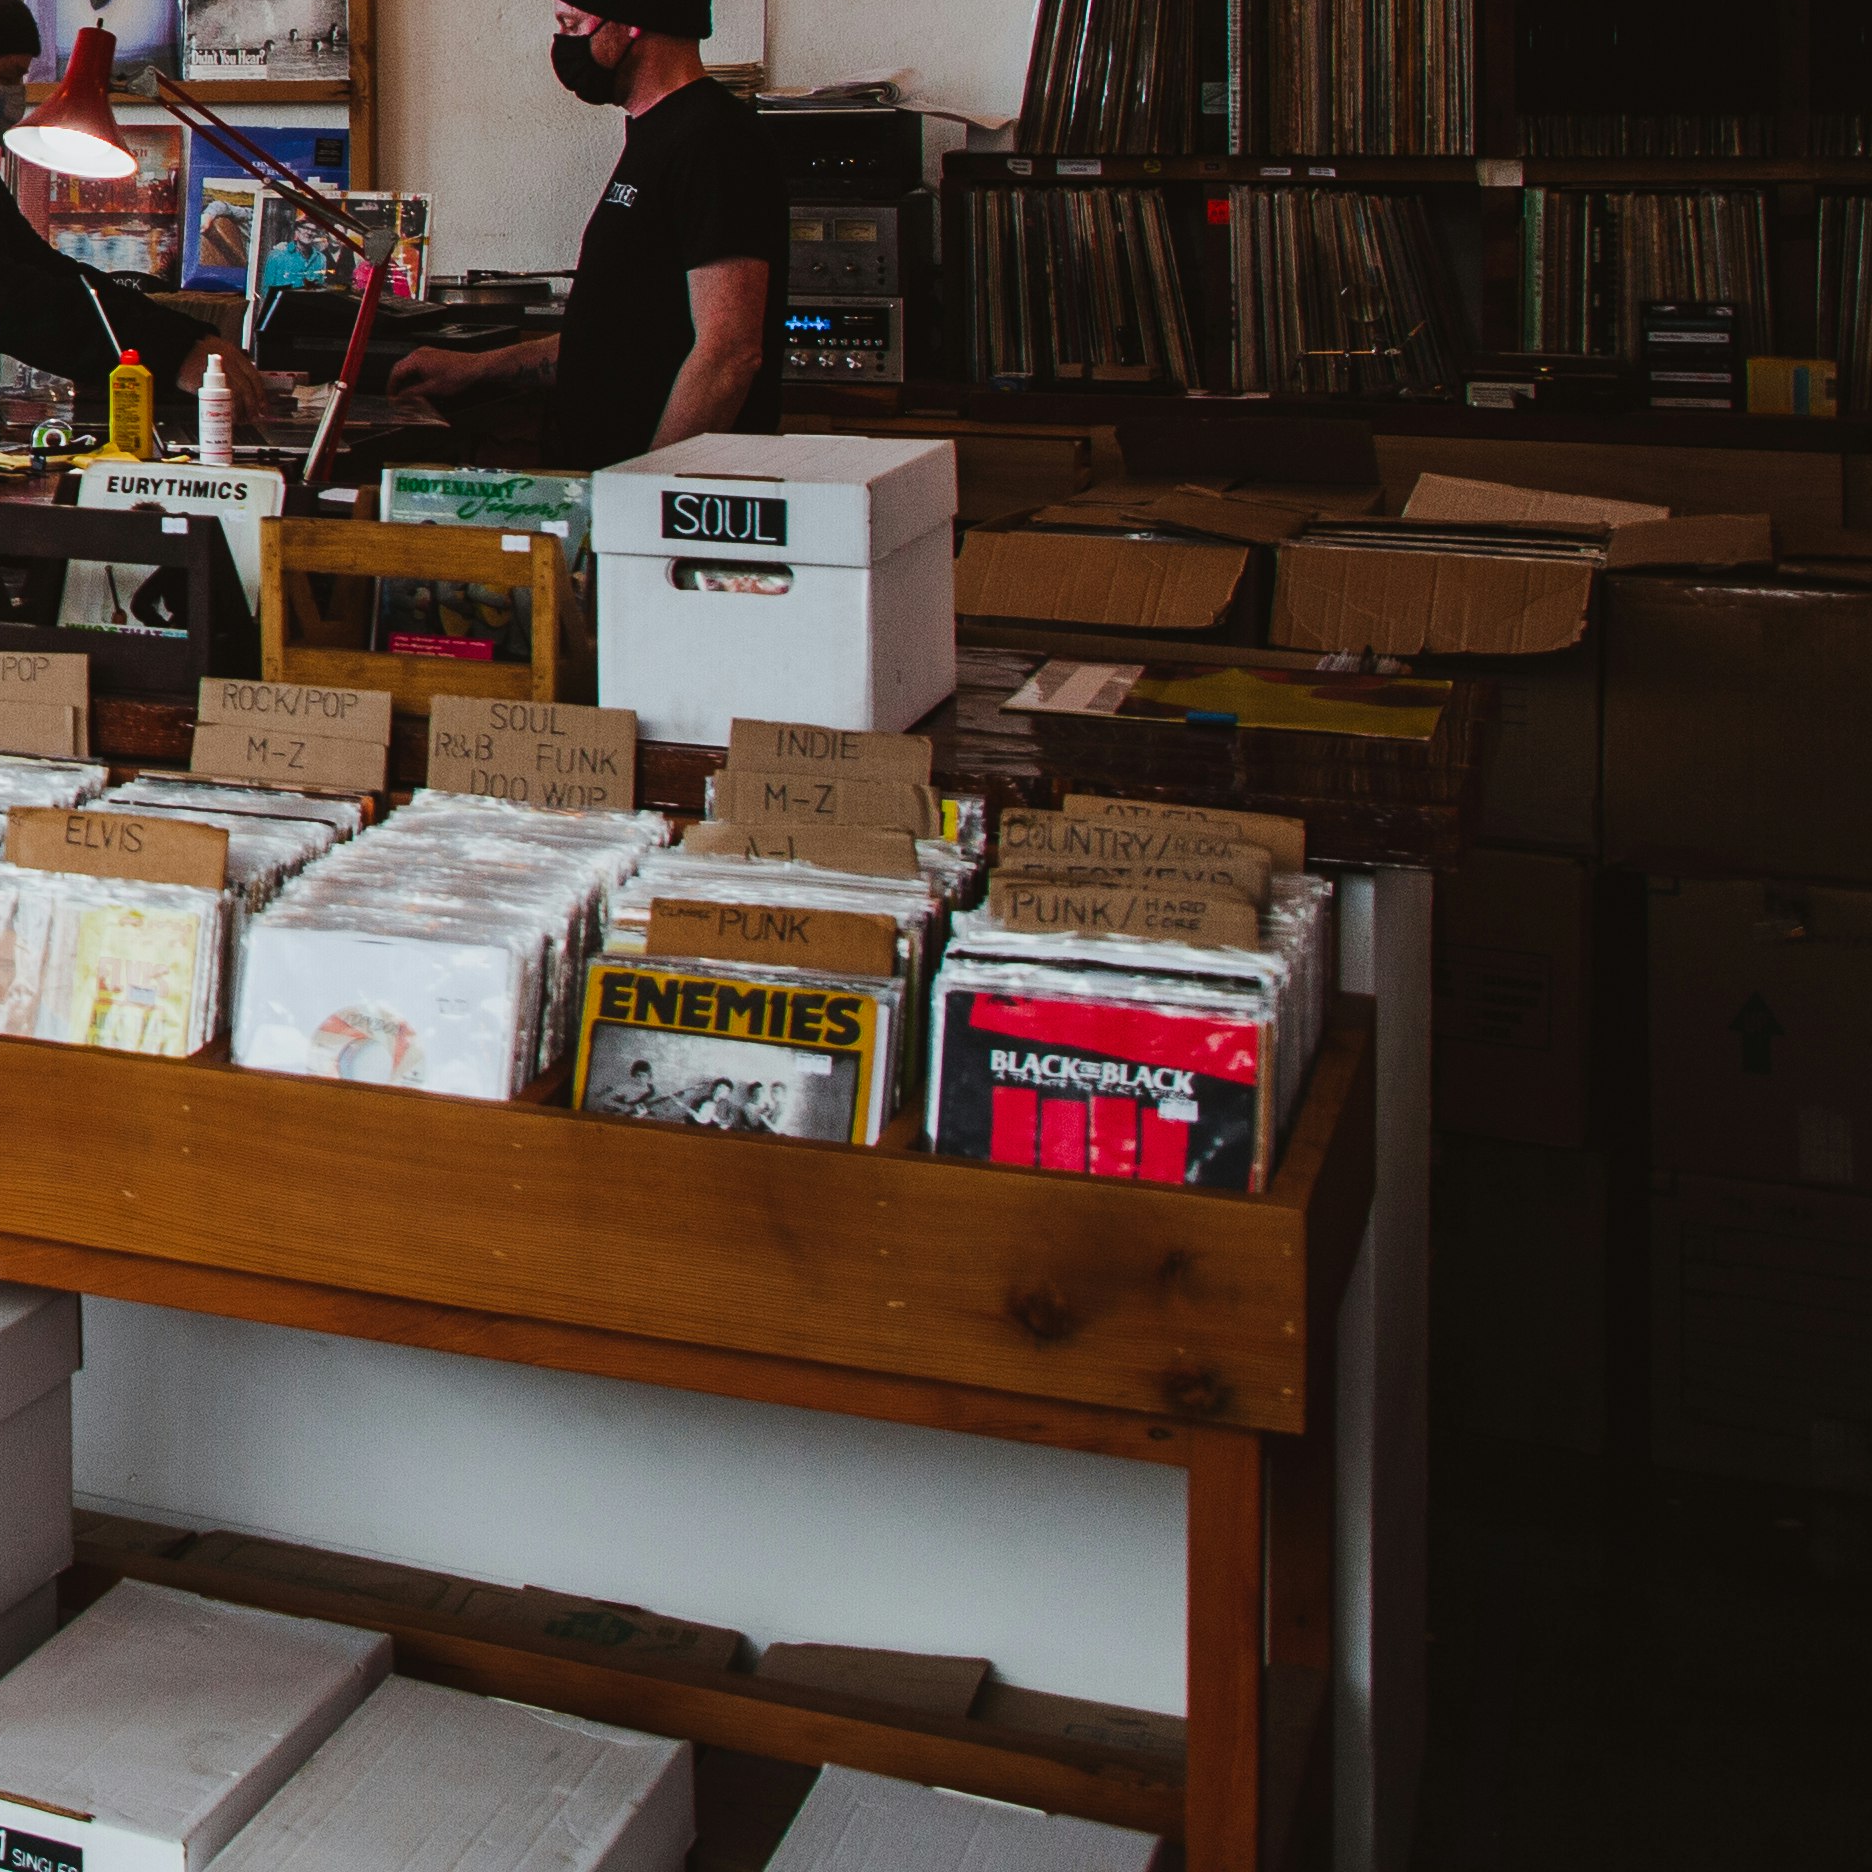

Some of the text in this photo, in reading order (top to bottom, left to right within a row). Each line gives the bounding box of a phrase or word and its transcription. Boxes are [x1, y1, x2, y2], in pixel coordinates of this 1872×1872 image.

[191, 48, 266, 65] Didn't You Hear?
[107, 475, 249, 501] EURYTHMICS
[396, 476, 534, 499] HOOTENANNY
[671, 493, 779, 543] SOUL
[221, 683, 358, 719] ROCK/POP
[489, 703, 566, 735] SOUL
[246, 739, 305, 769] M-Z
[435, 733, 619, 774] R&B FUNK
[775, 729, 862, 760] INDIE
[471, 770, 608, 810] DOO WOP
[764, 783, 834, 814] M-Z
[65, 815, 145, 853] ELVIS
[1144, 897, 1207, 914] HARD
[1145, 914, 1200, 929] CORE
[718, 908, 809, 945] PUNK
[599, 971, 865, 1047] ENEMIES
[990, 1049, 1196, 1093] BLACK BLACK
